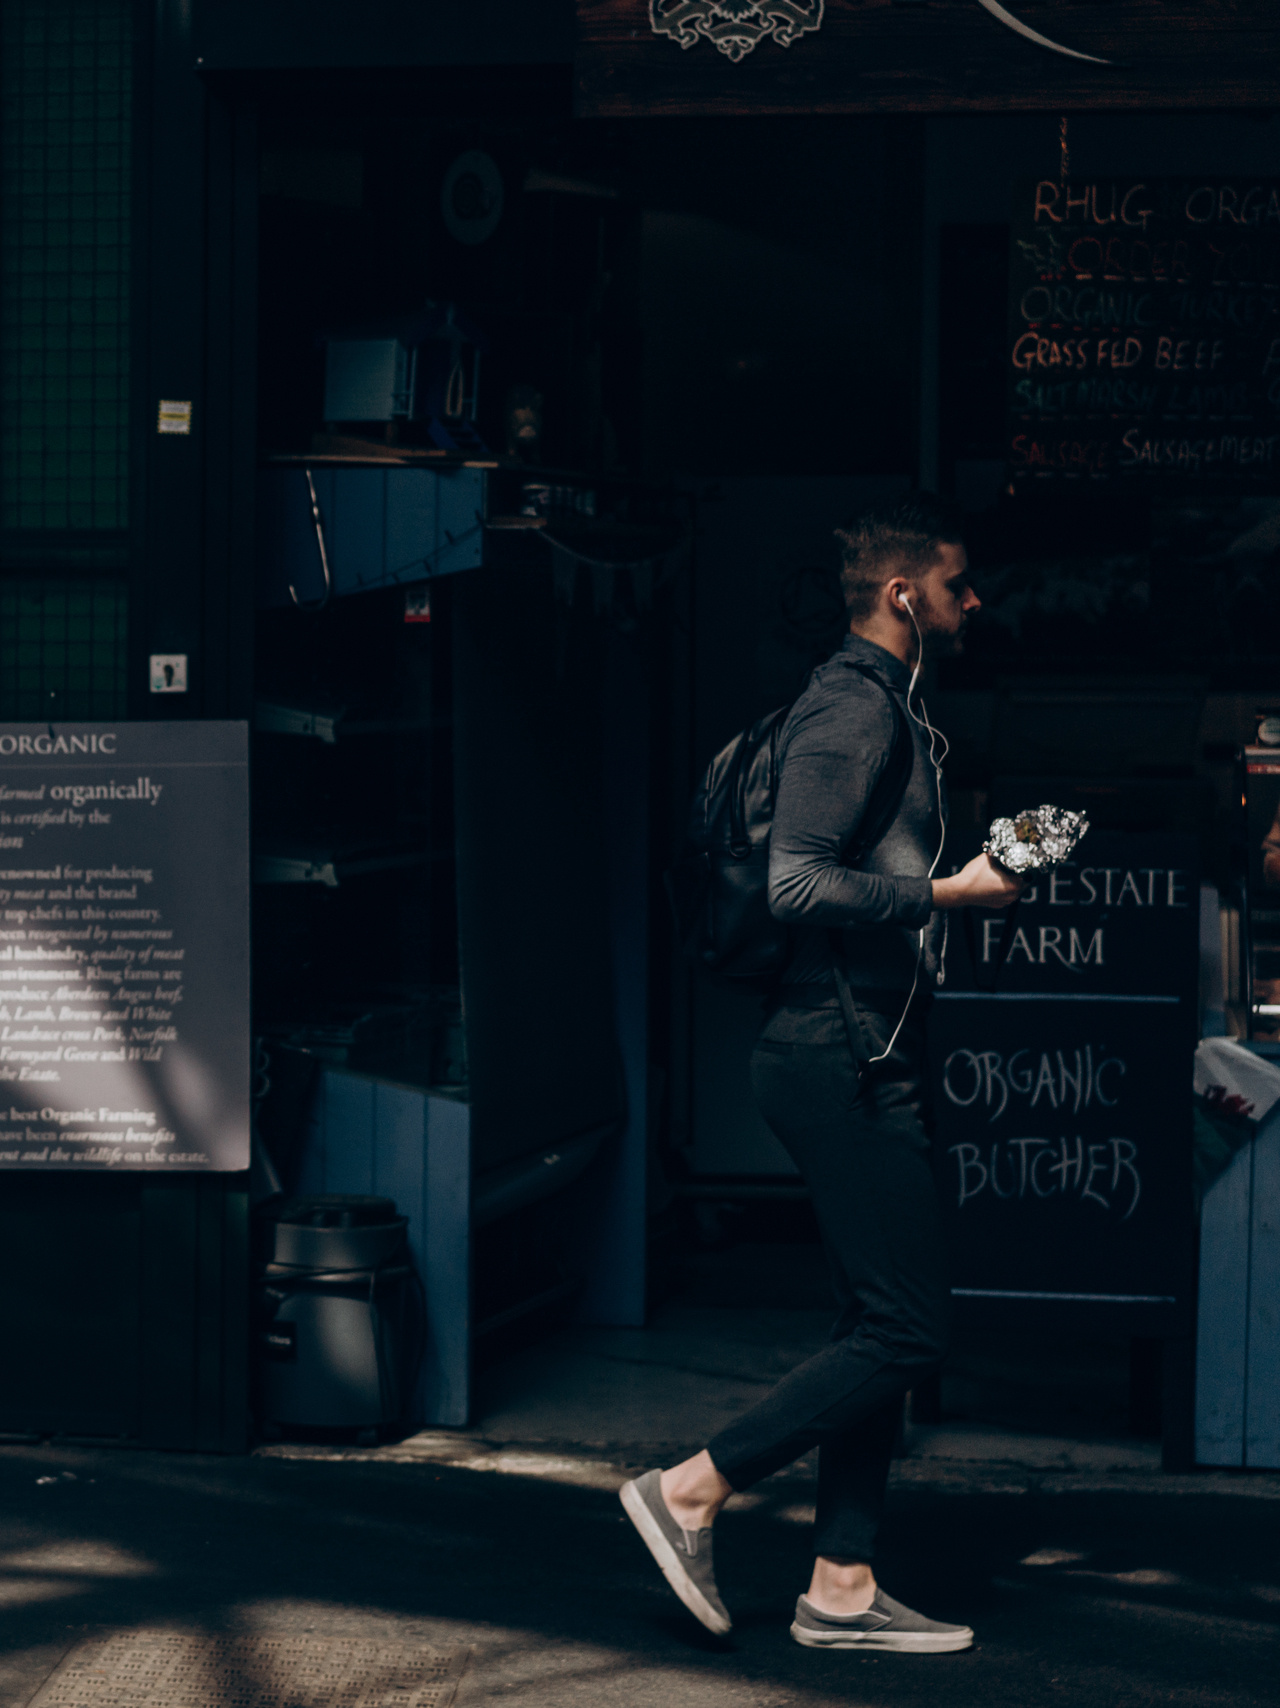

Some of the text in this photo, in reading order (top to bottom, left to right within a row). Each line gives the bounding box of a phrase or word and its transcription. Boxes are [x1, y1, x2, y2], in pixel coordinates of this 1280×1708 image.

[1034, 180, 1154, 232] RHUG
[1020, 285, 1158, 327] ORGANIC
[1012, 331, 1088, 371] GRASS
[1097, 336, 1143, 368] FED
[1154, 335, 1225, 370] BEEF
[50, 776, 163, 807] organically
[1048, 862, 1189, 907] ESTATE
[982, 918, 1106, 973] FARM
[943, 1044, 1126, 1122] ORGANIC
[948, 1135, 1140, 1221] BUTCHER
